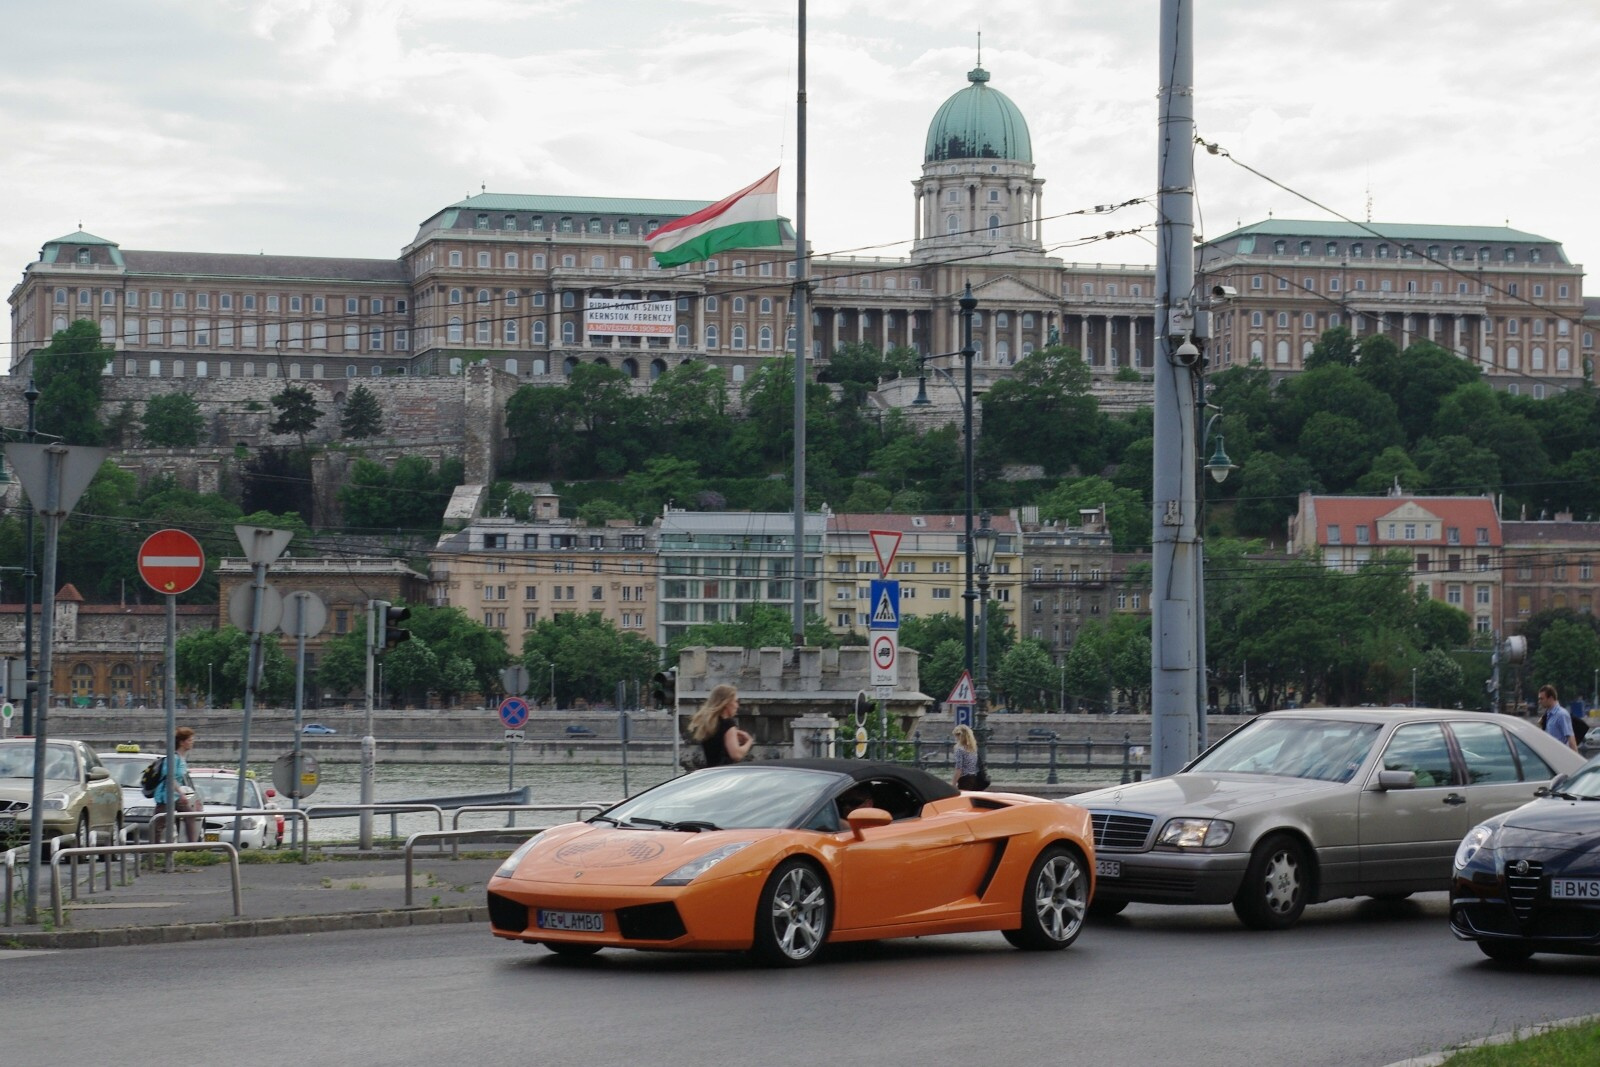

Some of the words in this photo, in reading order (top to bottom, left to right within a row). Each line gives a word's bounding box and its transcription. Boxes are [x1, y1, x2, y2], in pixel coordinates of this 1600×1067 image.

[642, 303, 672, 312] SZINYEI
[589, 312, 629, 321] KERNSTOK
[634, 313, 672, 322] FERENCZY
[958, 709, 967, 725] P
[1566, 881, 1600, 897] BWS
[544, 912, 558, 928] KE
[564, 913, 602, 930] LAMBO
